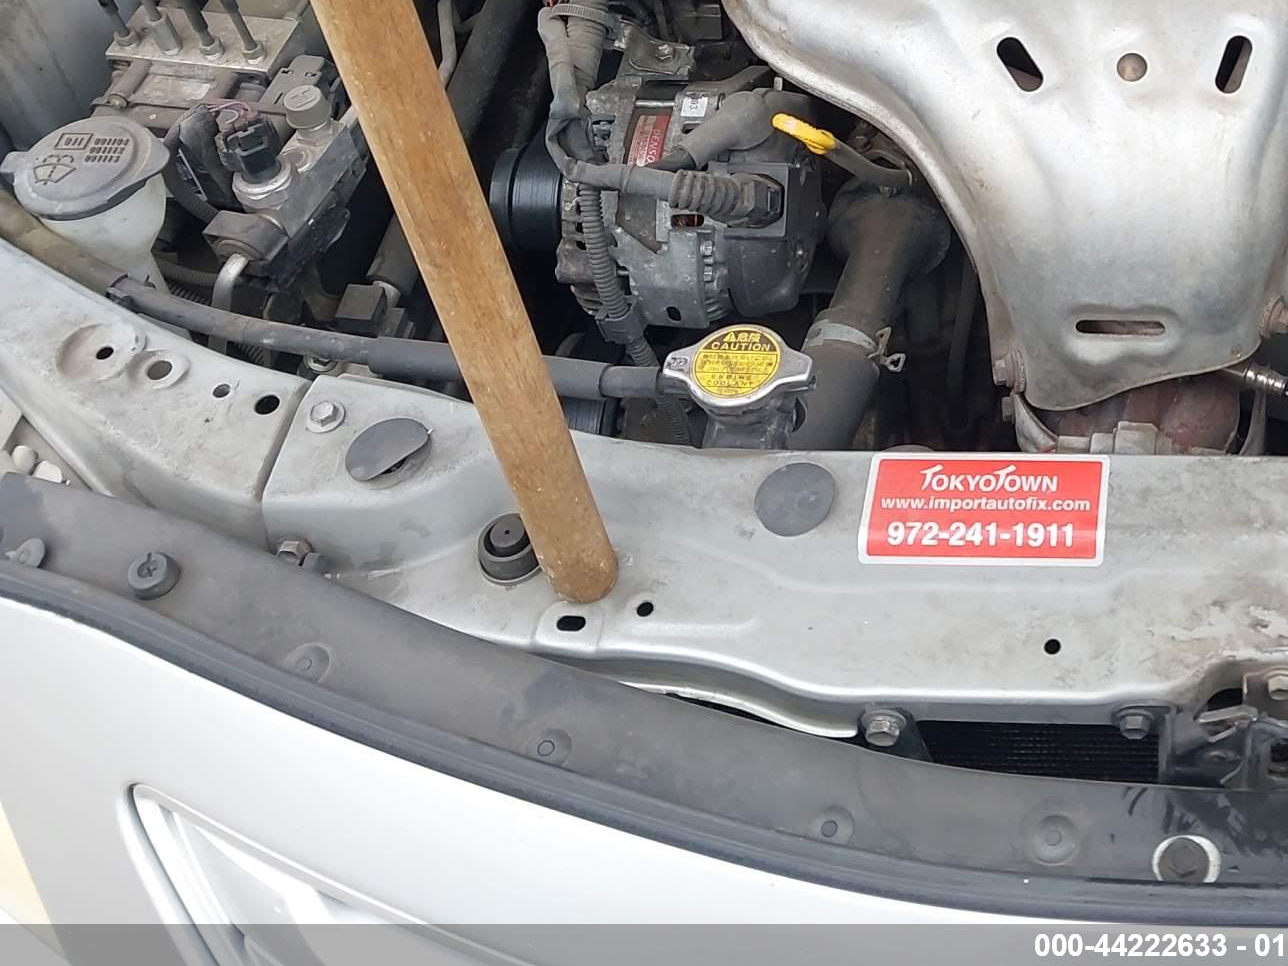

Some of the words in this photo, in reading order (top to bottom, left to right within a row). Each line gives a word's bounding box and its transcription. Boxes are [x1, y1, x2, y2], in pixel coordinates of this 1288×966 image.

[646, 129, 661, 163] DENSO
[711, 342, 771, 351] CAUTION
[881, 496, 1091, 512] www.importautofix.com
[887, 521, 1073, 547] 972-241-1911
